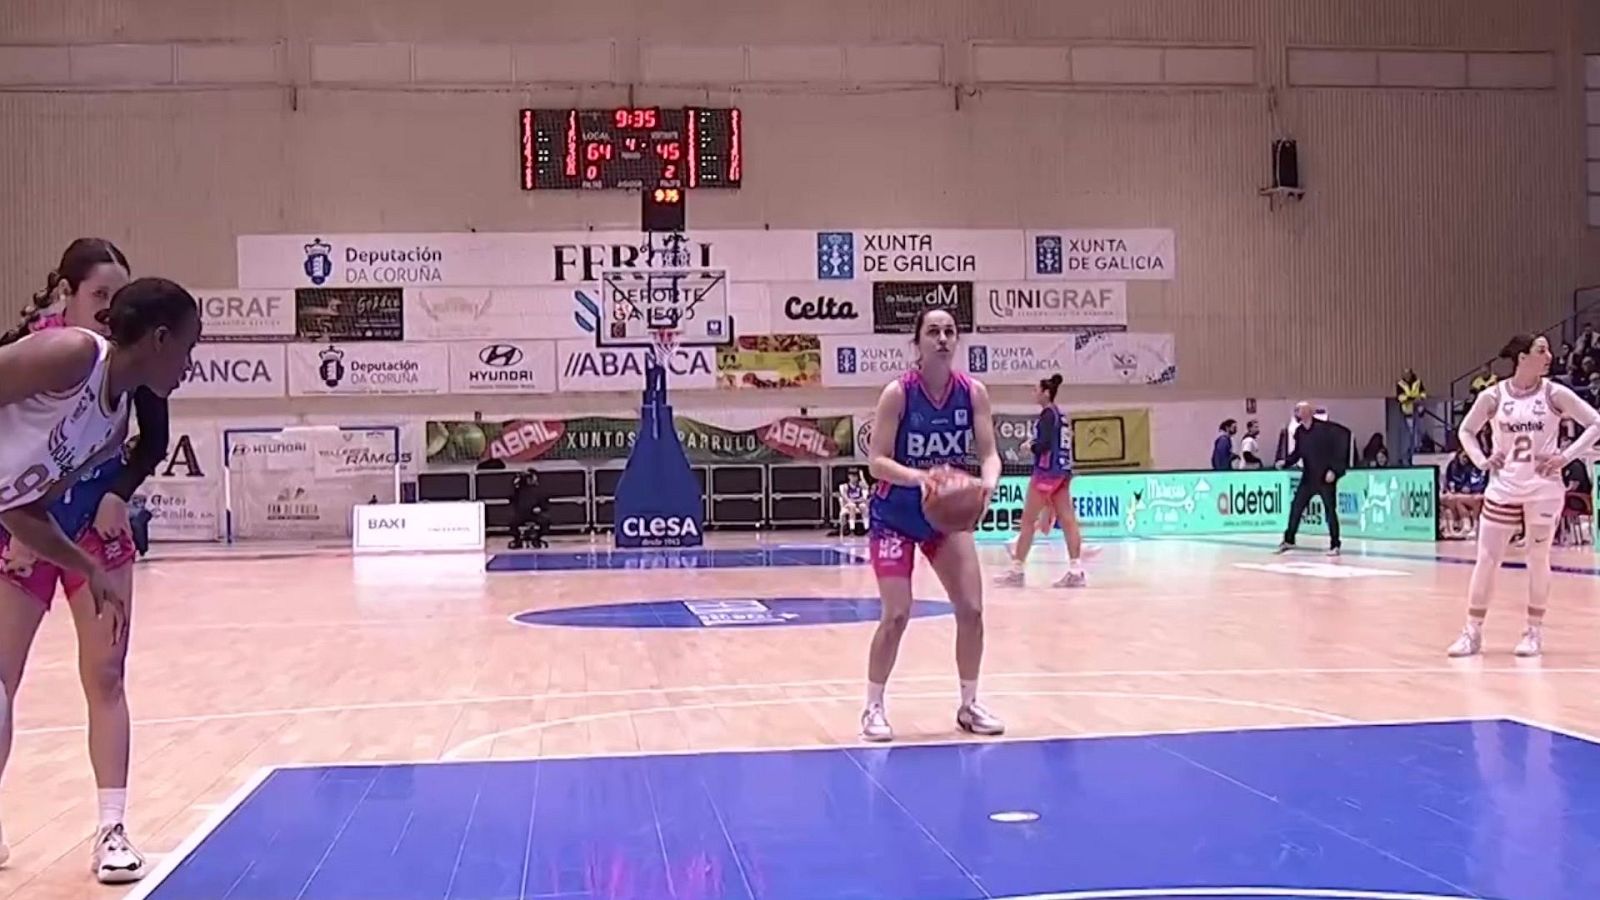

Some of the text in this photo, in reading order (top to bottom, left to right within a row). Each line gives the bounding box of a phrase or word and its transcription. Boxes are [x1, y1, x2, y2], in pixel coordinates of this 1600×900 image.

[616, 110, 656, 128] 9:35
[587, 143, 611, 160] 64
[625, 138, 636, 151] 4
[656, 143, 680, 160] 45
[586, 165, 597, 180] 0
[664, 165, 676, 179] 2
[863, 234, 932, 251] XUNTA
[1069, 238, 1127, 252] XUNTA
[345, 246, 442, 265] Deputación
[864, 254, 975, 272] DE GALICIA
[1069, 255, 1164, 271] DE GALICIA
[345, 266, 442, 283] DA CORUÑA
[925, 284, 958, 304] dM
[785, 296, 858, 319] Celta
[989, 289, 1113, 318] UNIGRAF
[861, 349, 903, 358] XUNTA
[992, 347, 1034, 357] XUNTA
[350, 359, 419, 373] Deputación
[860, 361, 883, 371] DE
[992, 359, 1062, 371] DE GALICIA
[350, 372, 419, 384] DA CORUÑA
[469, 370, 533, 381] HYUNDAI
[489, 419, 560, 460] ABRIL
[566, 431, 637, 449] XUNTOS
[764, 420, 831, 458] ABRIL
[906, 429, 974, 458] BAXI
[1512, 434, 1532, 463] 2
[345, 452, 413, 465] RAMOS
[1217, 483, 1281, 515] aldetail
[368, 518, 406, 530] BAXI
